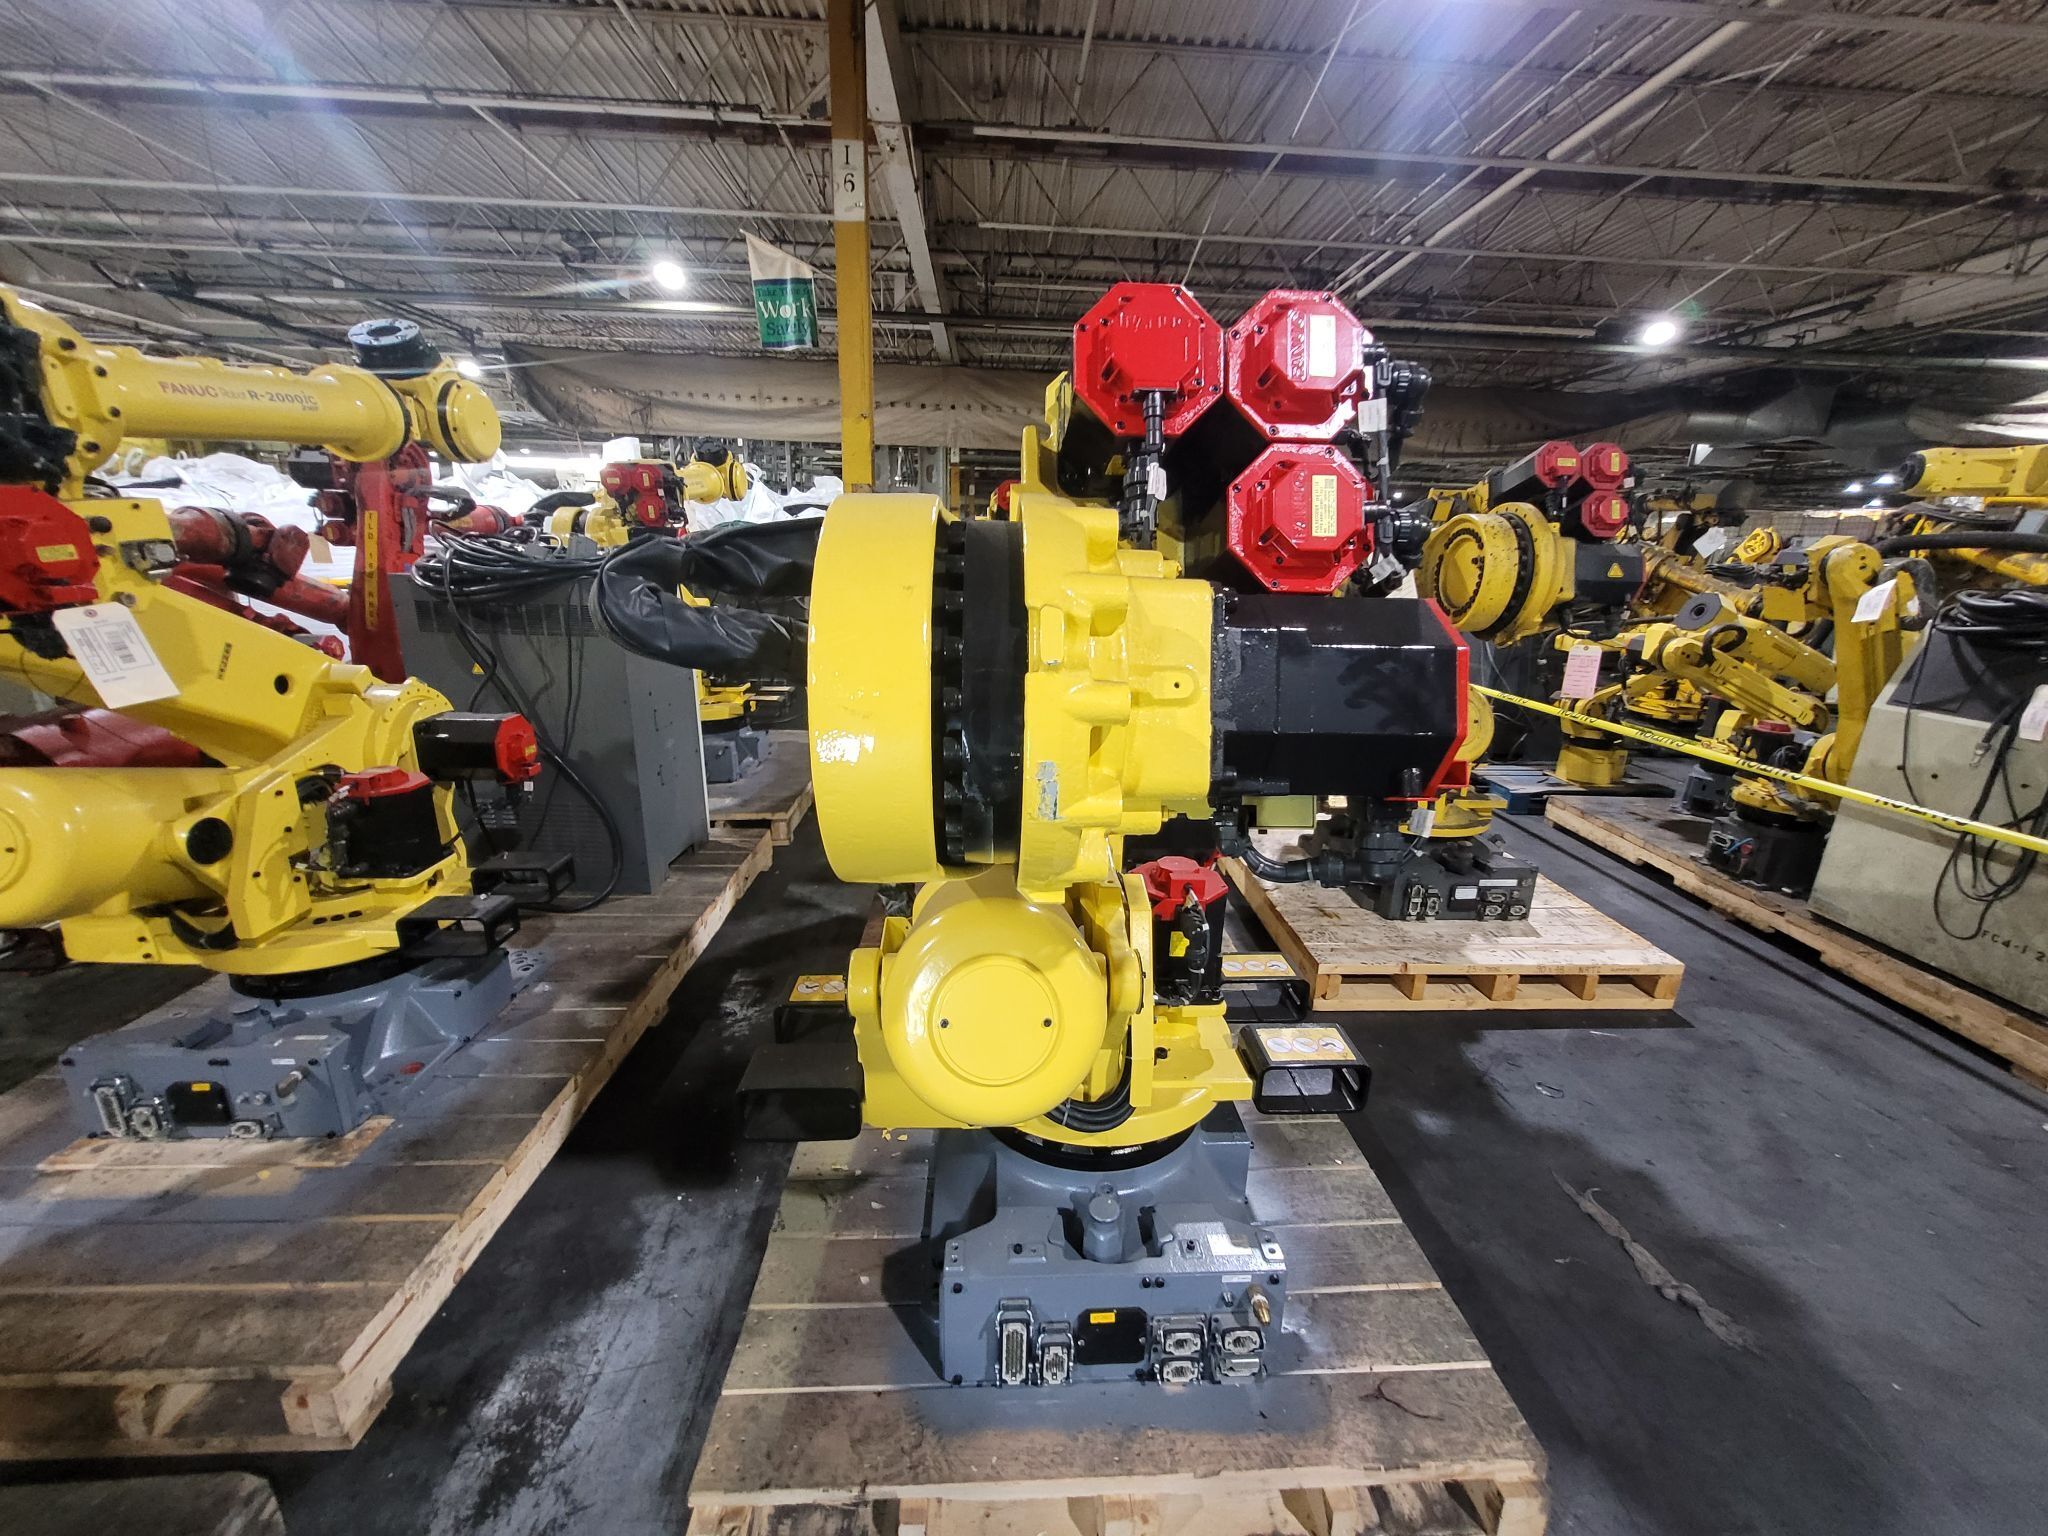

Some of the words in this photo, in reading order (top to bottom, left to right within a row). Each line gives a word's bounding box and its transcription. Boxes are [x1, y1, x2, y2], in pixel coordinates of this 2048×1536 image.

[843, 172, 855, 193] 6
[758, 297, 813, 319] Work
[158, 380, 218, 398] FANUC
[1636, 729, 1686, 748] CAUTION
